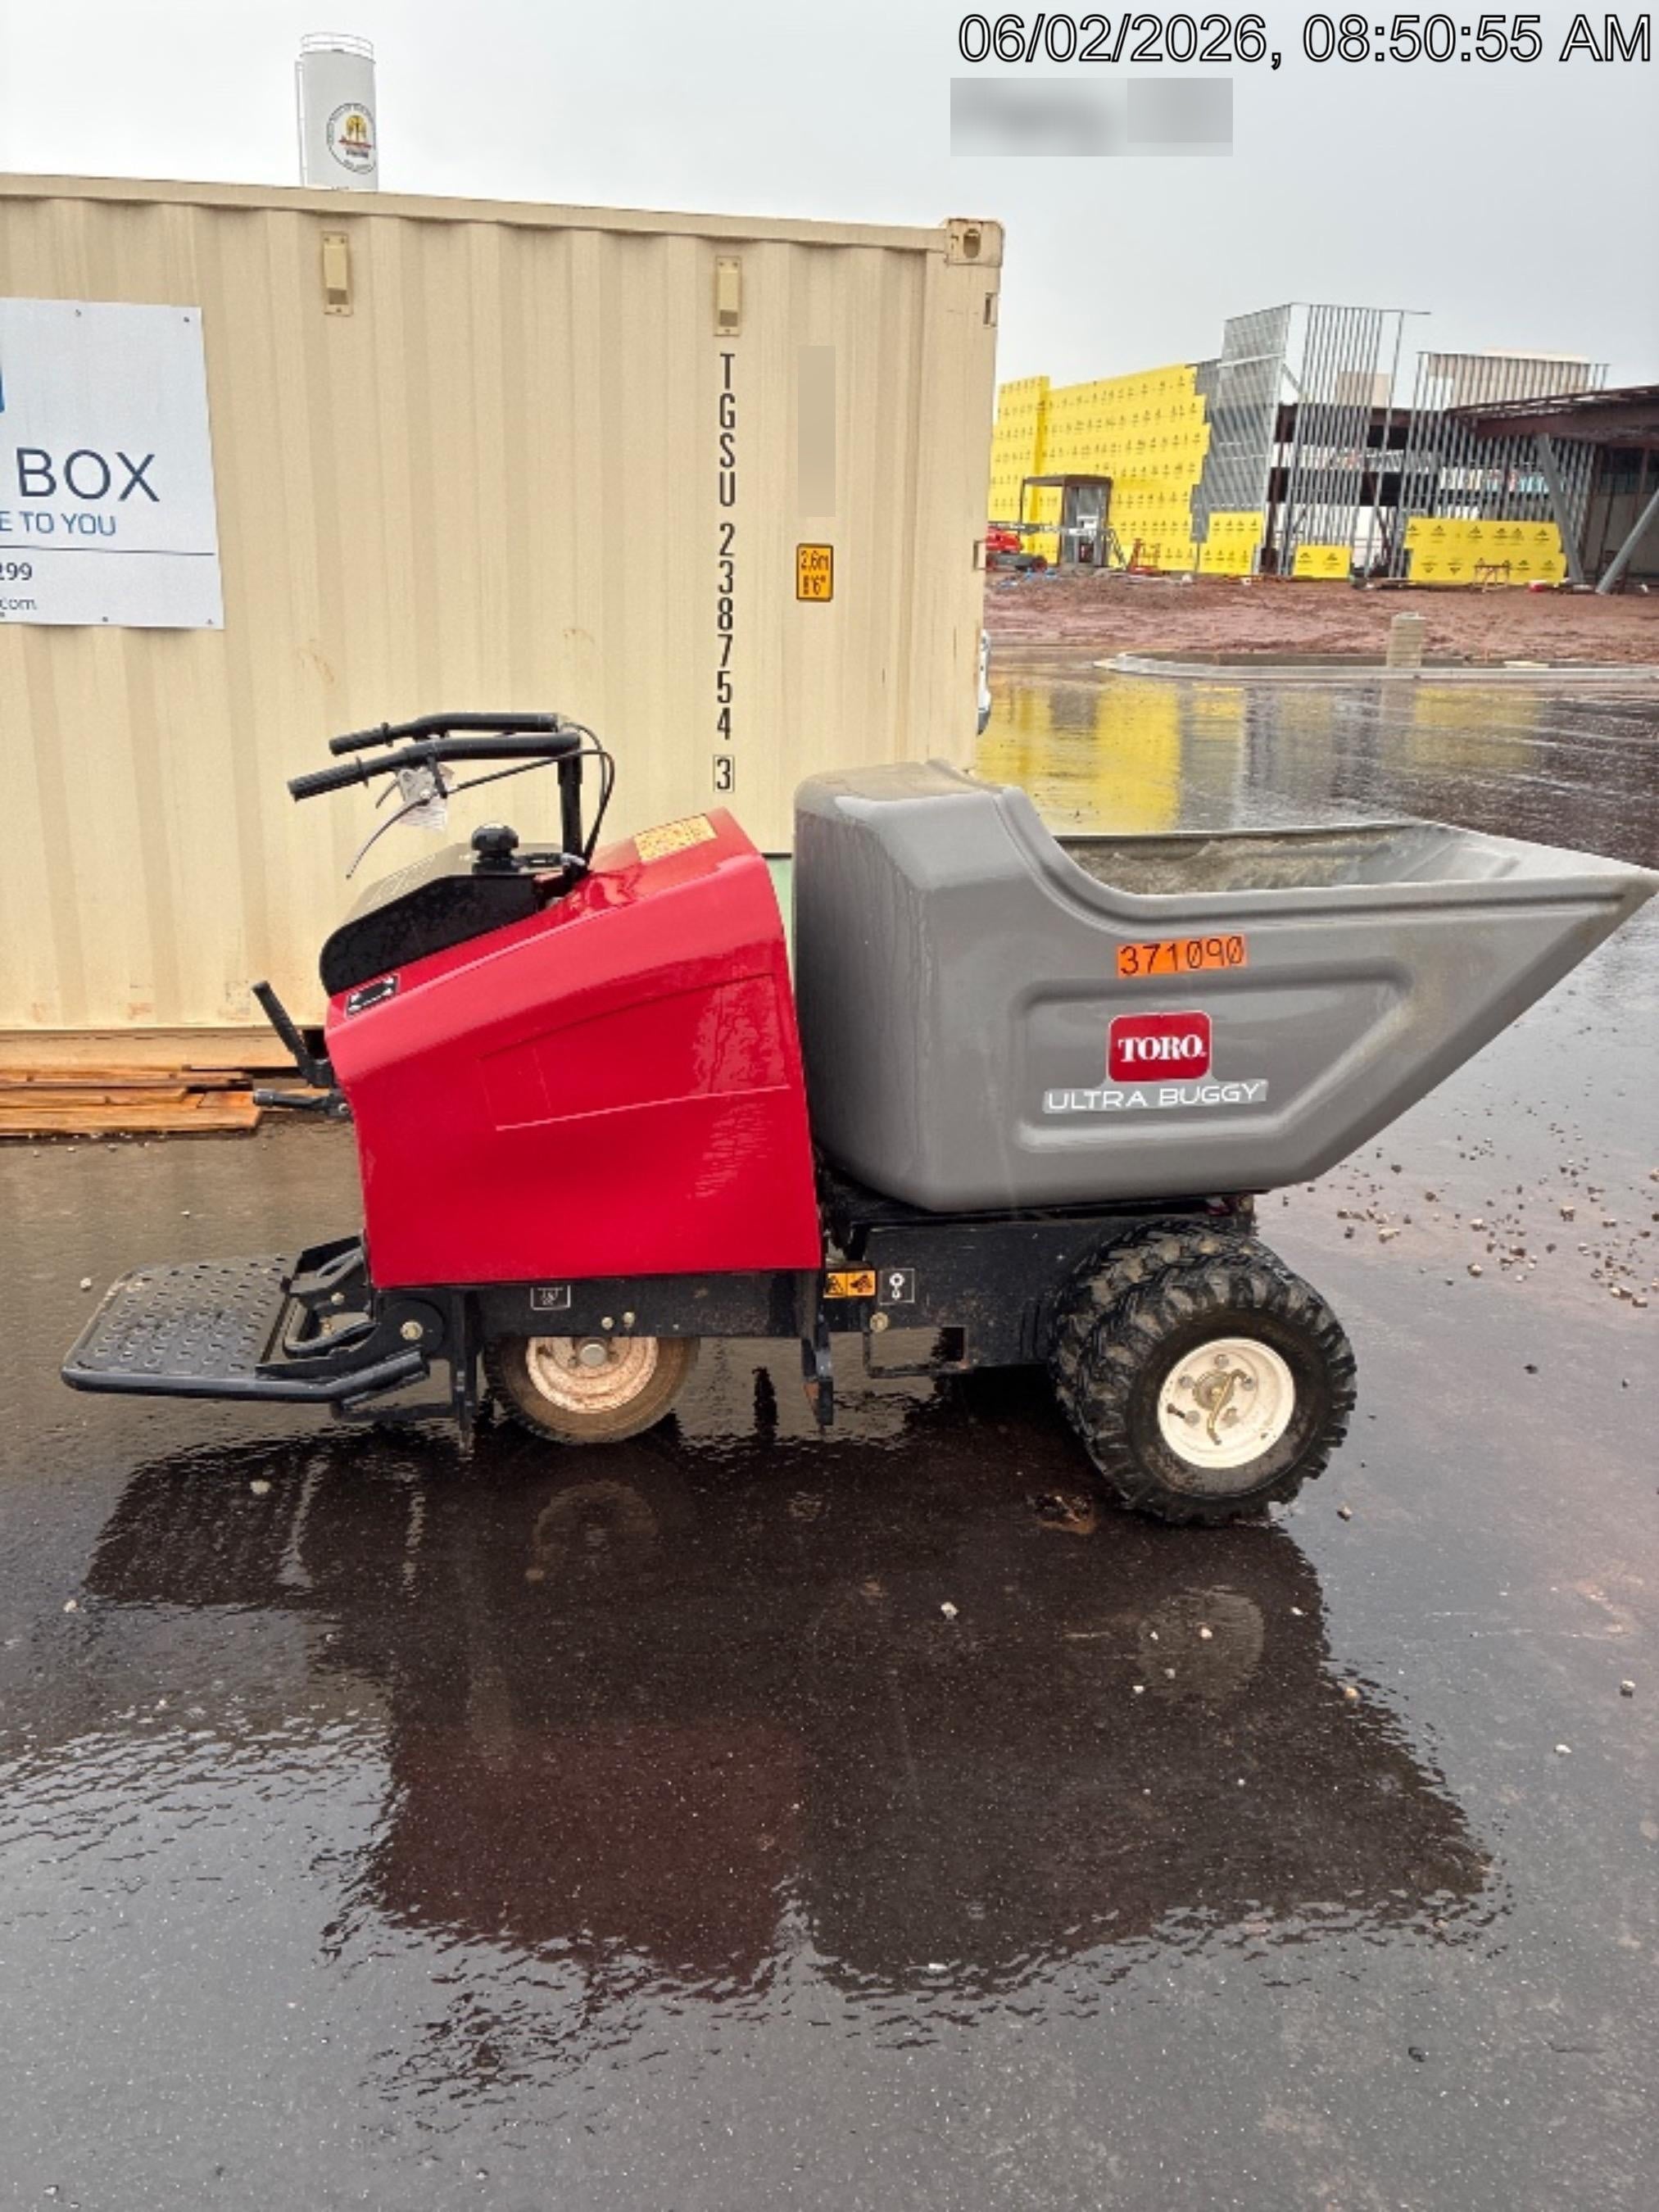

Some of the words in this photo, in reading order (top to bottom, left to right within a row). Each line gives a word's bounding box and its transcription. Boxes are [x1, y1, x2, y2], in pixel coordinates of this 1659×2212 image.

[719, 352, 736, 507] TGSU
[16, 447, 160, 502] BOX
[19, 511, 55, 534] TO
[60, 513, 116, 537] YOU
[716, 523, 735, 741] 238754
[716, 758, 732, 790] 3
[1119, 936, 1244, 976] 371090
[1117, 1034, 1203, 1063] TORO
[1047, 1090, 1149, 1110] ULTRA
[1158, 1082, 1259, 1105] BUGGY
